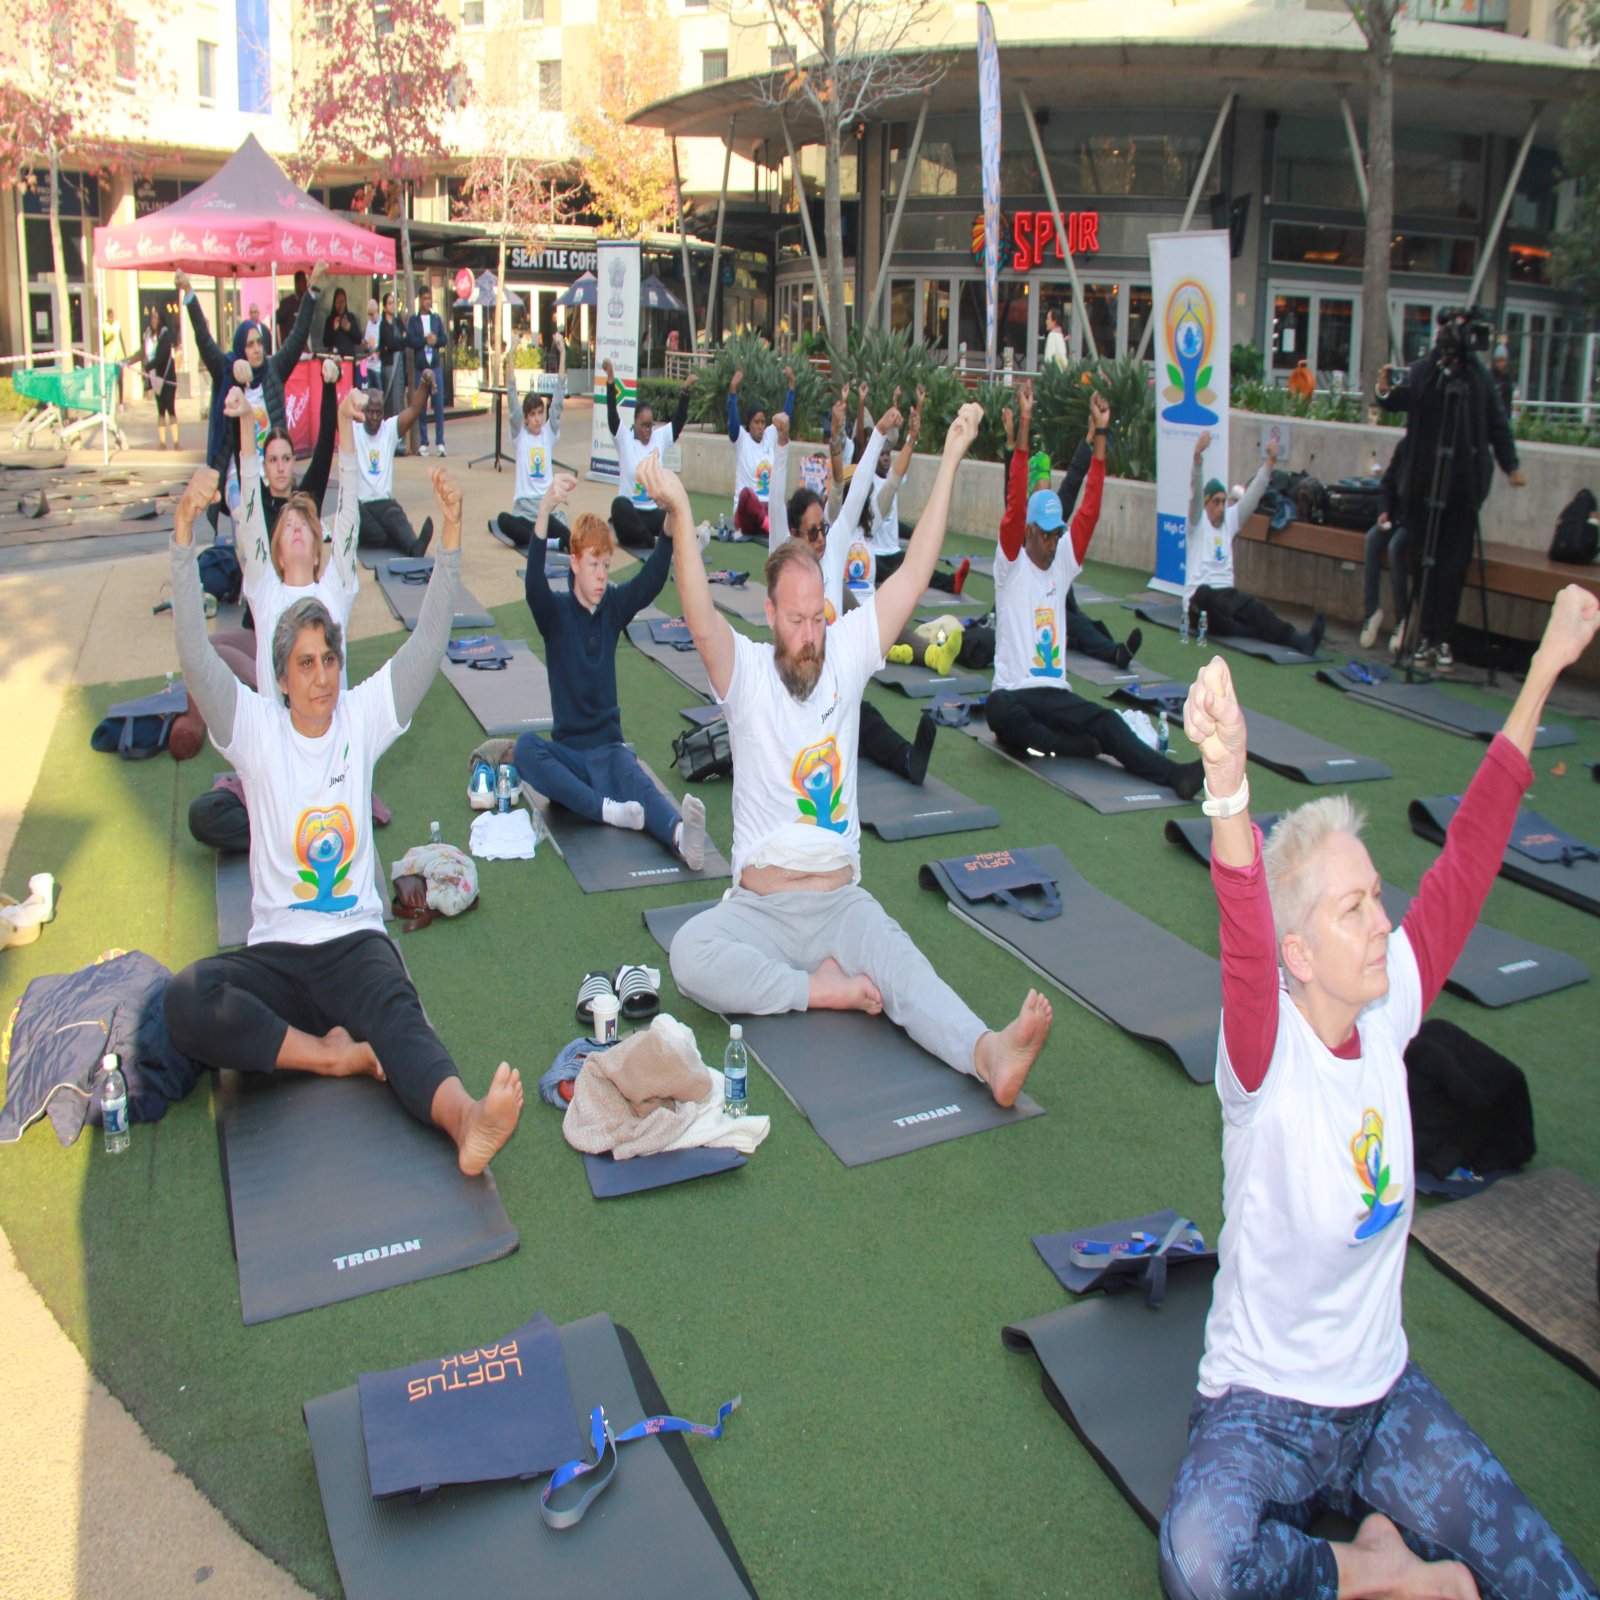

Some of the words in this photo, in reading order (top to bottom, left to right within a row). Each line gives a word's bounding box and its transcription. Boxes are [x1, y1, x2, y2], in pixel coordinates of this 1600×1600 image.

[1013, 211, 1099, 271] SPUR
[512, 248, 567, 269] SEATTLE
[964, 856, 1016, 871] LOFTUS
[893, 1104, 961, 1127] TROJAN
[332, 1239, 422, 1271] TROJAN
[441, 1340, 518, 1371] PARK
[407, 1357, 523, 1402] LOFTUS
